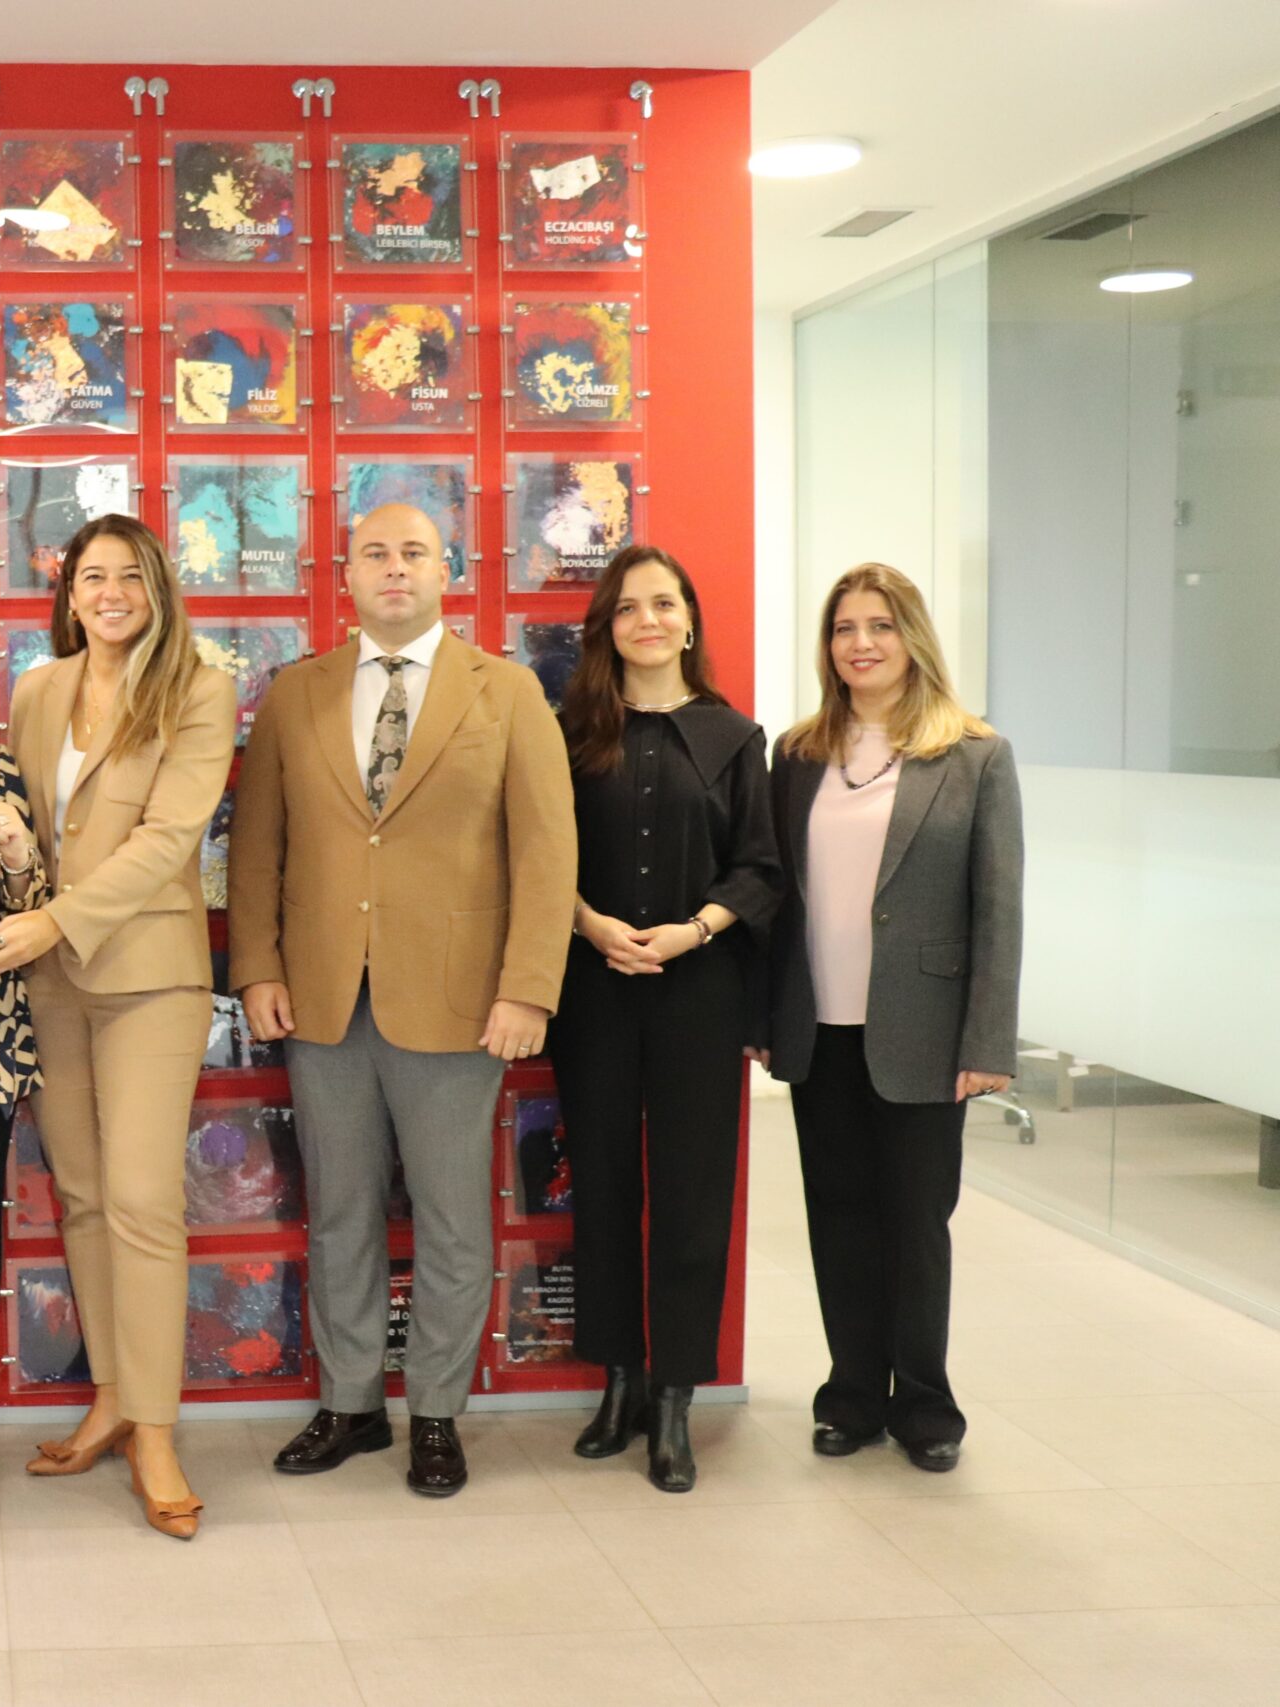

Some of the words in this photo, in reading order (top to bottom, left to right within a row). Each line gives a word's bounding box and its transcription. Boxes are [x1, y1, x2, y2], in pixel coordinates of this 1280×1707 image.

[375, 224, 425, 236] BEYLEM
[544, 221, 614, 235] ECZACIBAŞI
[70, 384, 113, 397] FATMA
[247, 387, 278, 401] FİLİZ
[576, 384, 620, 396] GAMZE
[411, 402, 435, 411] USTA
[241, 550, 286, 562] MUTLU
